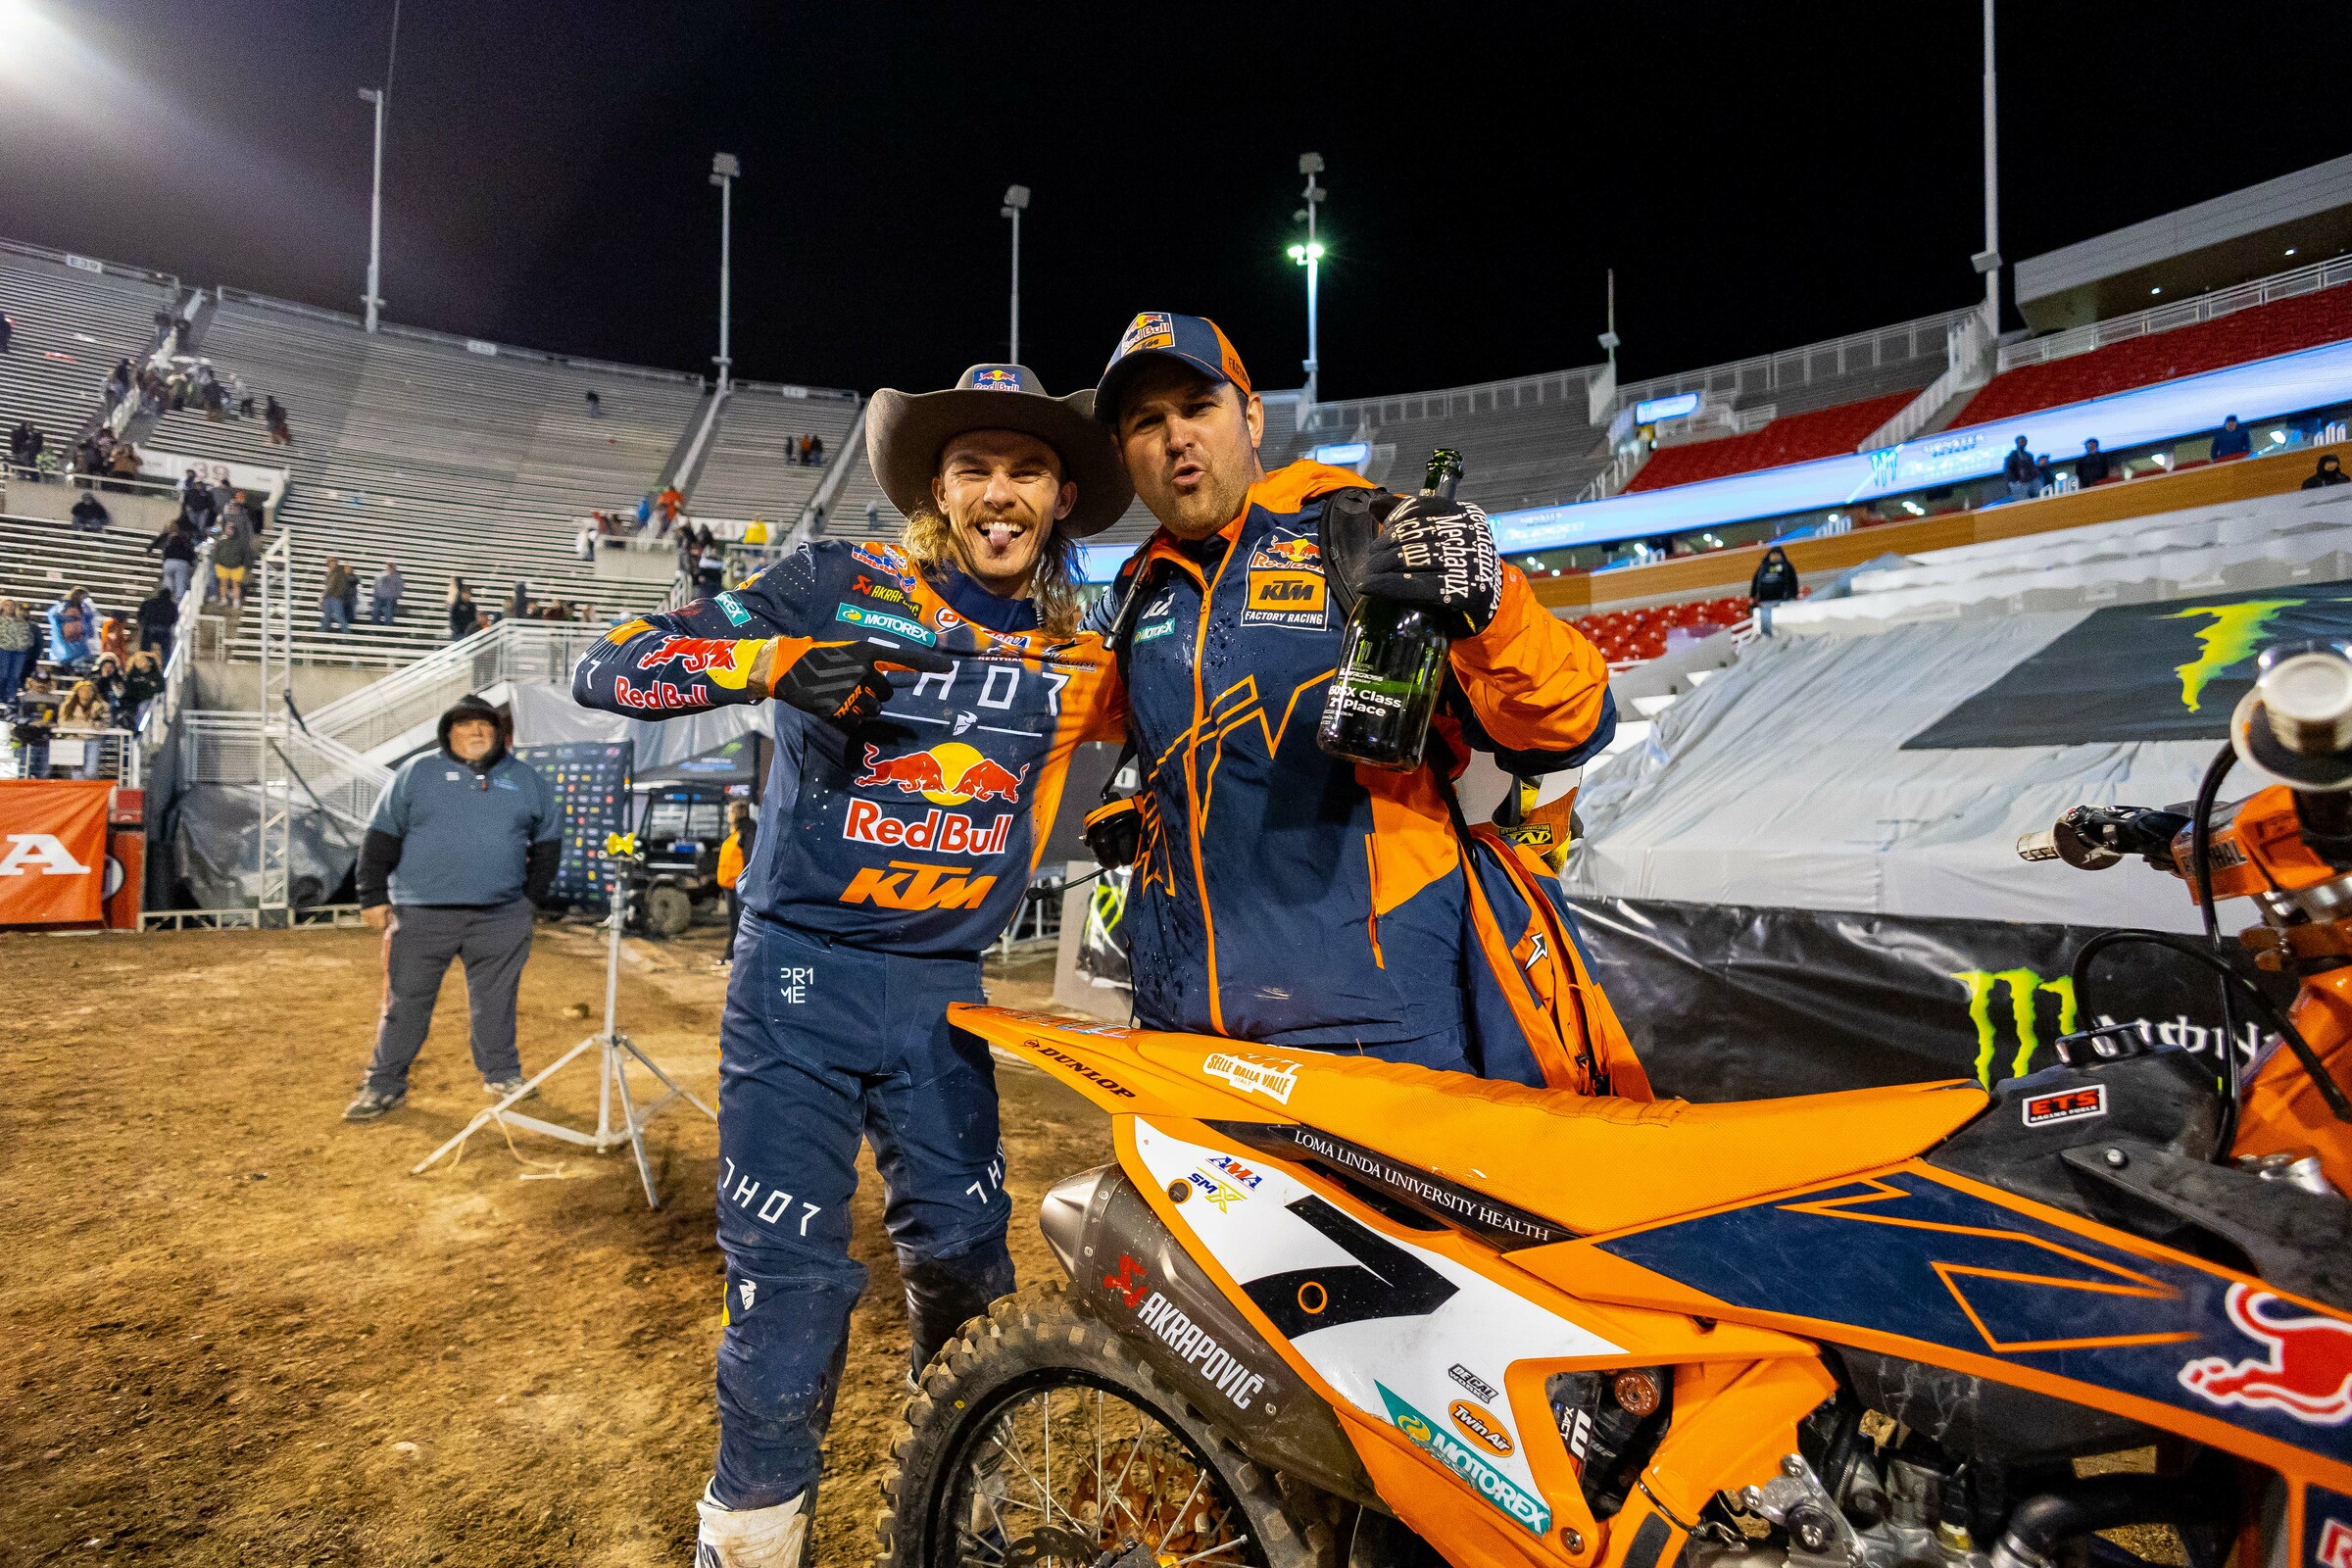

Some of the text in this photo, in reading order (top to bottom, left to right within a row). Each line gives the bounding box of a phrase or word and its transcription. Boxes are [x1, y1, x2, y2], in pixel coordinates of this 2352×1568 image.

[1143, 322, 1170, 338] Bull
[1432, 514, 1477, 599] Mechanix
[1258, 580, 1315, 600] KTM
[864, 613, 931, 642] MOTOREX
[1245, 612, 1323, 624] FACTORY RACING
[615, 675, 711, 710] Red Bull
[834, 685, 861, 718] THOR
[1344, 699, 1386, 716] Place
[1359, 690, 1402, 708] Class
[843, 797, 1014, 856] Red Bull
[839, 860, 998, 911] KTM
[1037, 1048, 1137, 1098] DUNLOP
[1207, 1054, 1290, 1096] SELLE DALLA VALLE
[1235, 1077, 1252, 1086] ITALY
[2031, 1089, 2098, 1115] ETS
[1207, 1155, 1262, 1189] AMA
[1294, 1131, 1549, 1242] LOMA LINDA UNIVERSITY HEALTH
[1187, 1173, 1242, 1214] SMX
[1240, 1195, 1460, 1341] 7
[1452, 1366, 1496, 1398] DECAL
[1454, 1404, 1512, 1452] Twin Air
[1560, 1406, 1575, 1441] XACT
[1432, 1432, 1549, 1534] MOTOREX
